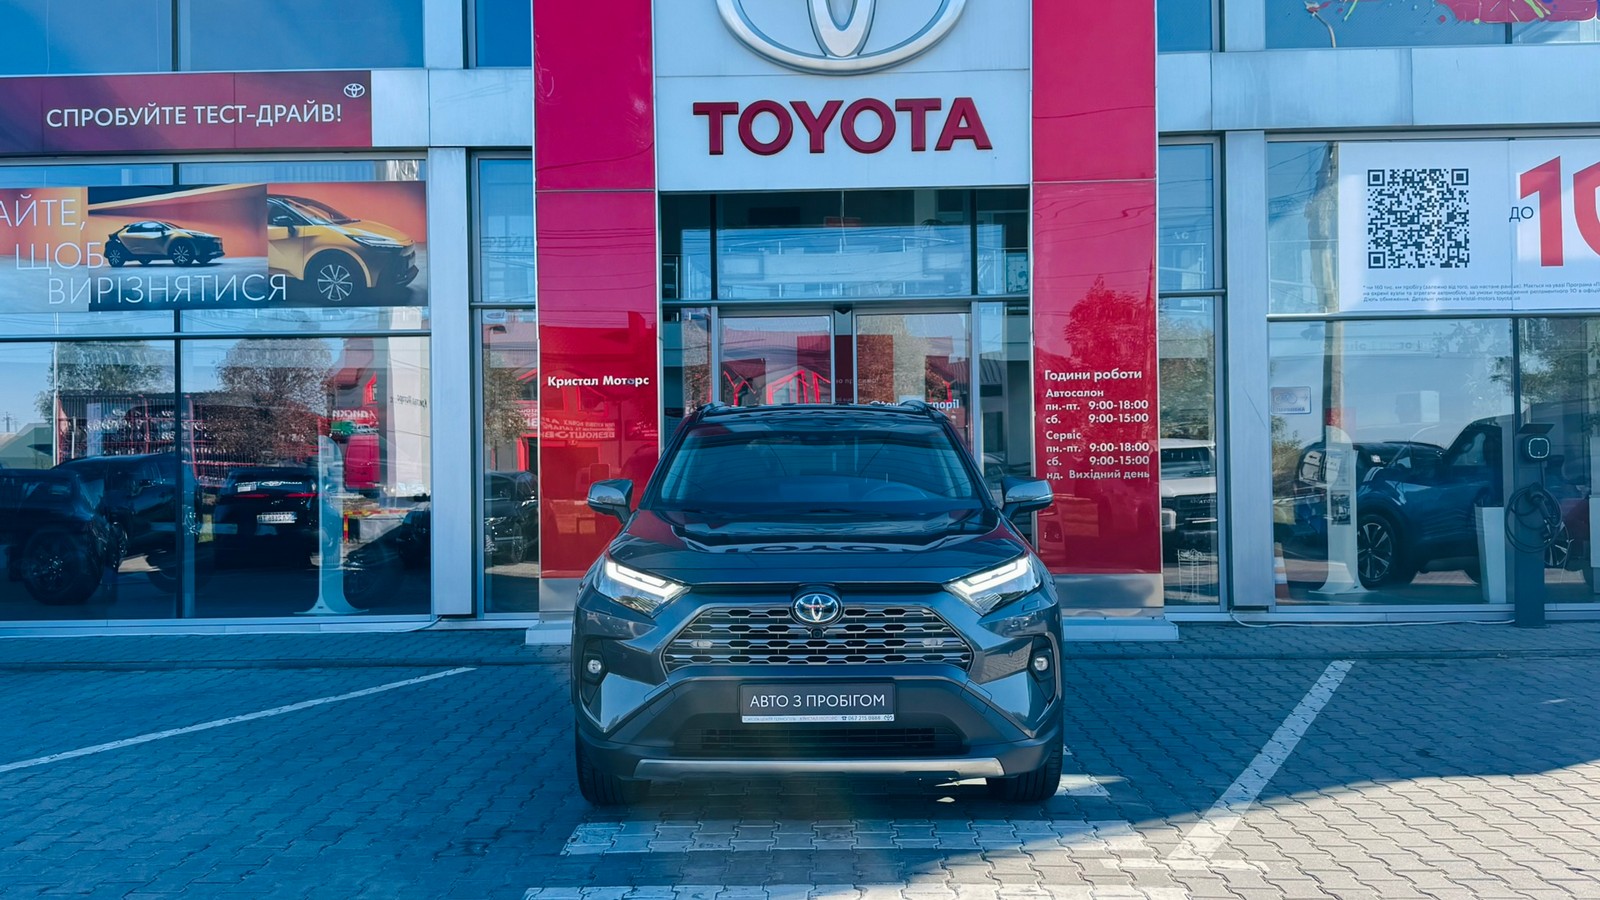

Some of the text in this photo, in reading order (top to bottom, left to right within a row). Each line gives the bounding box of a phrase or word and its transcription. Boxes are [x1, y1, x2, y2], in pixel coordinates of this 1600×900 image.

[46, 100, 343, 128] СПРОБУЙТЕ ТЕСТ-ДРАЙВ!
[693, 97, 993, 156] TOYOTA
[16, 242, 105, 275] ЩОБ
[47, 273, 287, 305] ВИРІЗНЯТИСЯ
[1044, 368, 1142, 382] Години роботи
[547, 375, 650, 389] Кристал Моторс
[1045, 389, 1104, 398] Автосалон
[1045, 400, 1149, 411] пн.-пт. 9:00-18:00
[1045, 413, 1149, 424] сб. 9:00-15:00
[1045, 430, 1082, 442] Сервіс
[1046, 442, 1150, 453] пн.-пт. 9:00-18:00
[1046, 456, 1150, 466] сб. 9:00-15:00
[1046, 469, 1150, 481] нд. Вихідний день
[750, 694, 885, 708] АВТО З ПРОБІГОМ
